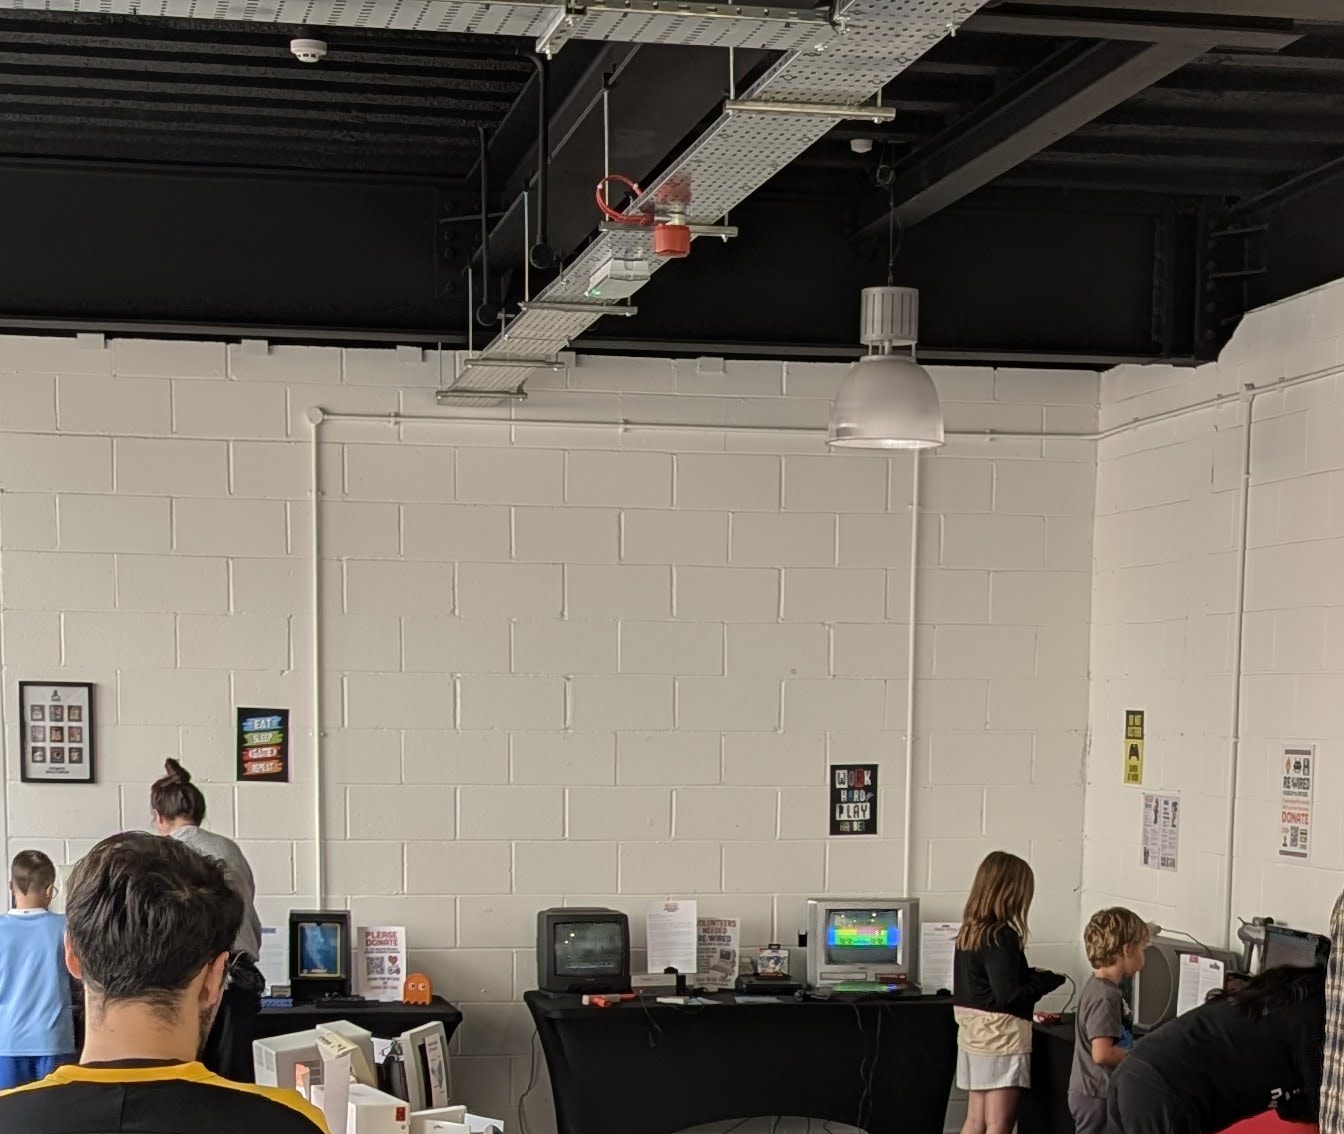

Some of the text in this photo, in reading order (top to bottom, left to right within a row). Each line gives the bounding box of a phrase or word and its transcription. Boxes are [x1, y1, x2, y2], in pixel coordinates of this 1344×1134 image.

[837, 803, 869, 819] PLAY
[1281, 810, 1309, 825] DONATE
[365, 931, 398, 939] PLEASE
[365, 939, 398, 947] DONATE
